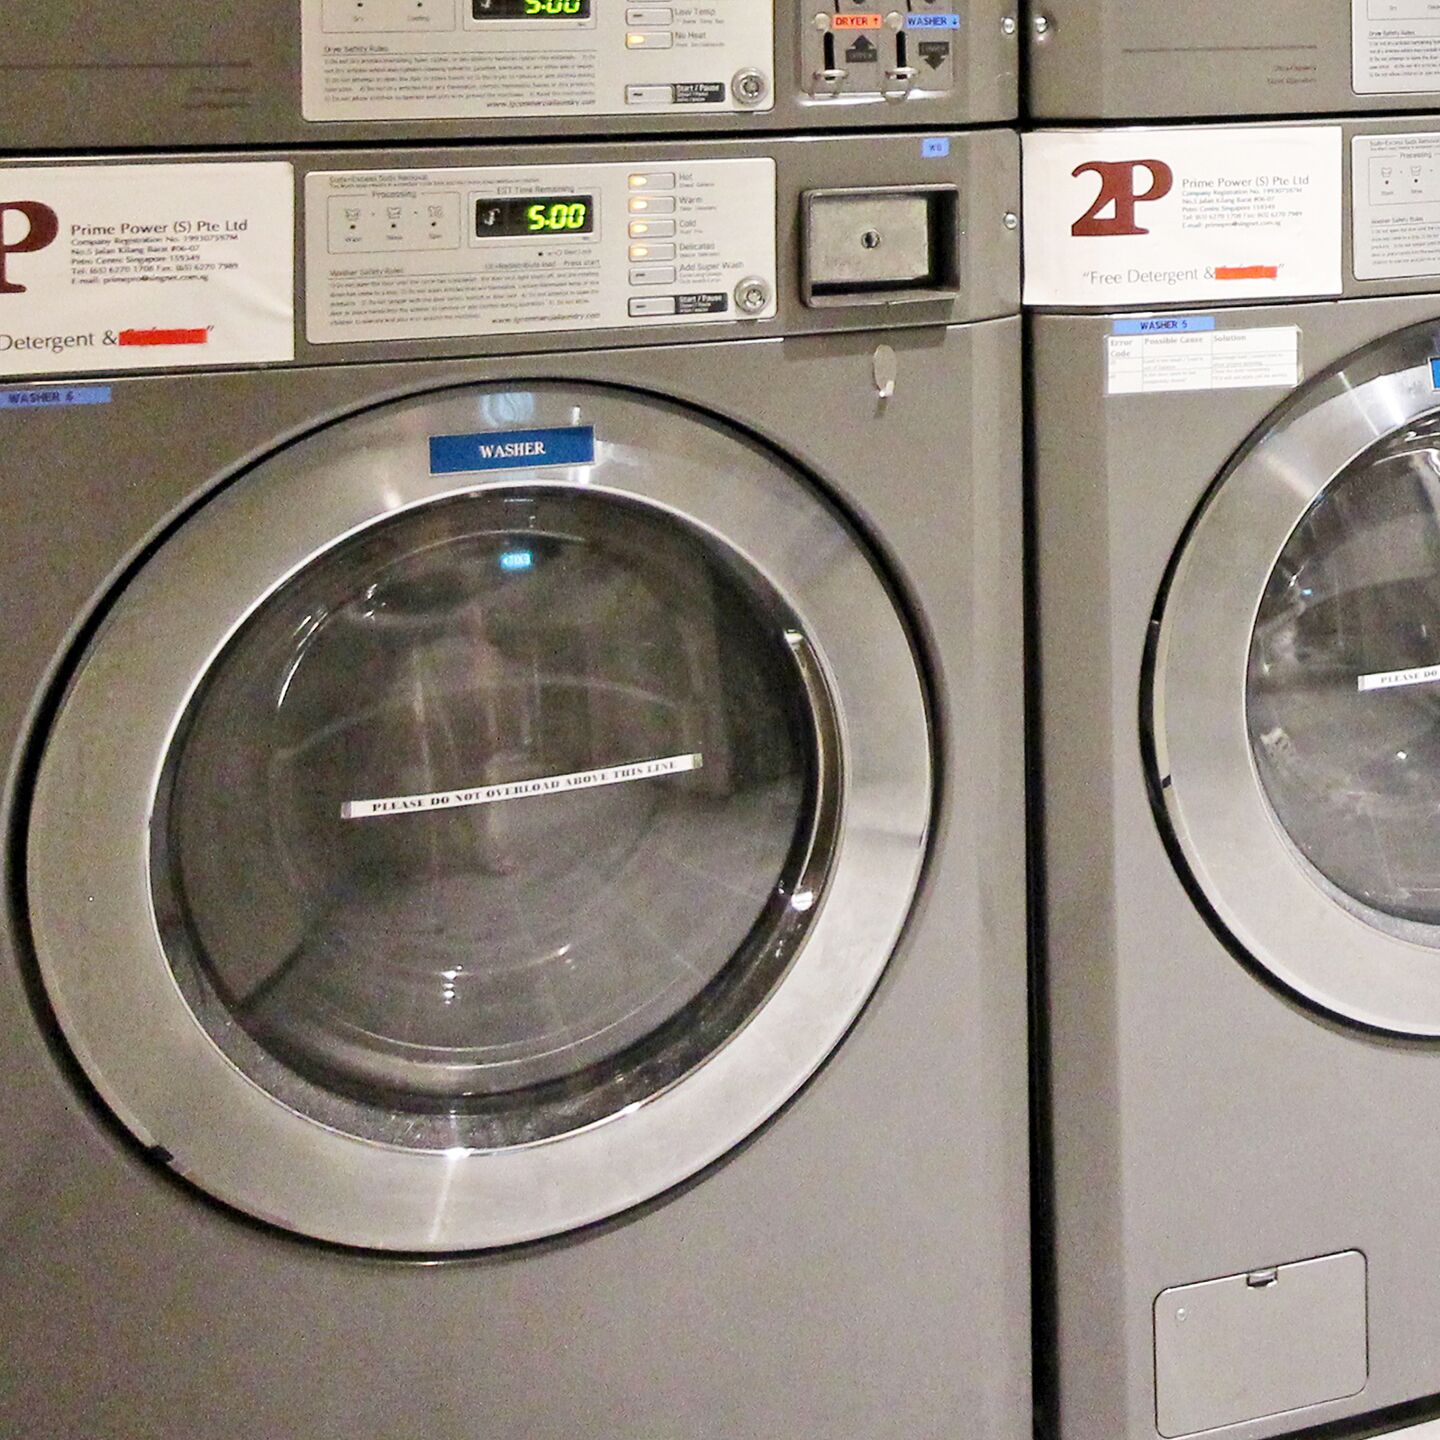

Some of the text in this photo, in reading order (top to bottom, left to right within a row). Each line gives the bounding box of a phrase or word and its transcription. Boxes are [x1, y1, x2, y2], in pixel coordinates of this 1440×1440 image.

[835, 17, 868, 26] DRYER
[907, 16, 947, 26] WASHER
[1182, 173, 1309, 188] Prime Power (S) Pte Ltd
[1071, 158, 1173, 237] 2P
[528, 203, 586, 230] 5.00
[71, 219, 248, 236] Prime Power (S) Pte Ltd
[1127, 267, 1199, 286] Detergent
[1203, 266, 1214, 280] &
[1140, 319, 1188, 330] WASHER 5
[0, 333, 94, 354] Detergent
[102, 329, 117, 346] &
[1110, 339, 1133, 348] Error
[1144, 335, 1203, 345] Possible Cause
[1214, 333, 1247, 342] Solution
[1110, 350, 1131, 358] Code
[8, 390, 60, 404] WASHER
[480, 441, 546, 459] WASHER
[1380, 672, 1419, 684] PLEASE
[1423, 669, 1438, 678] DO
[372, 760, 676, 812] PLEASE DO NOT OVERLOAD ABOVE THIS LINE
